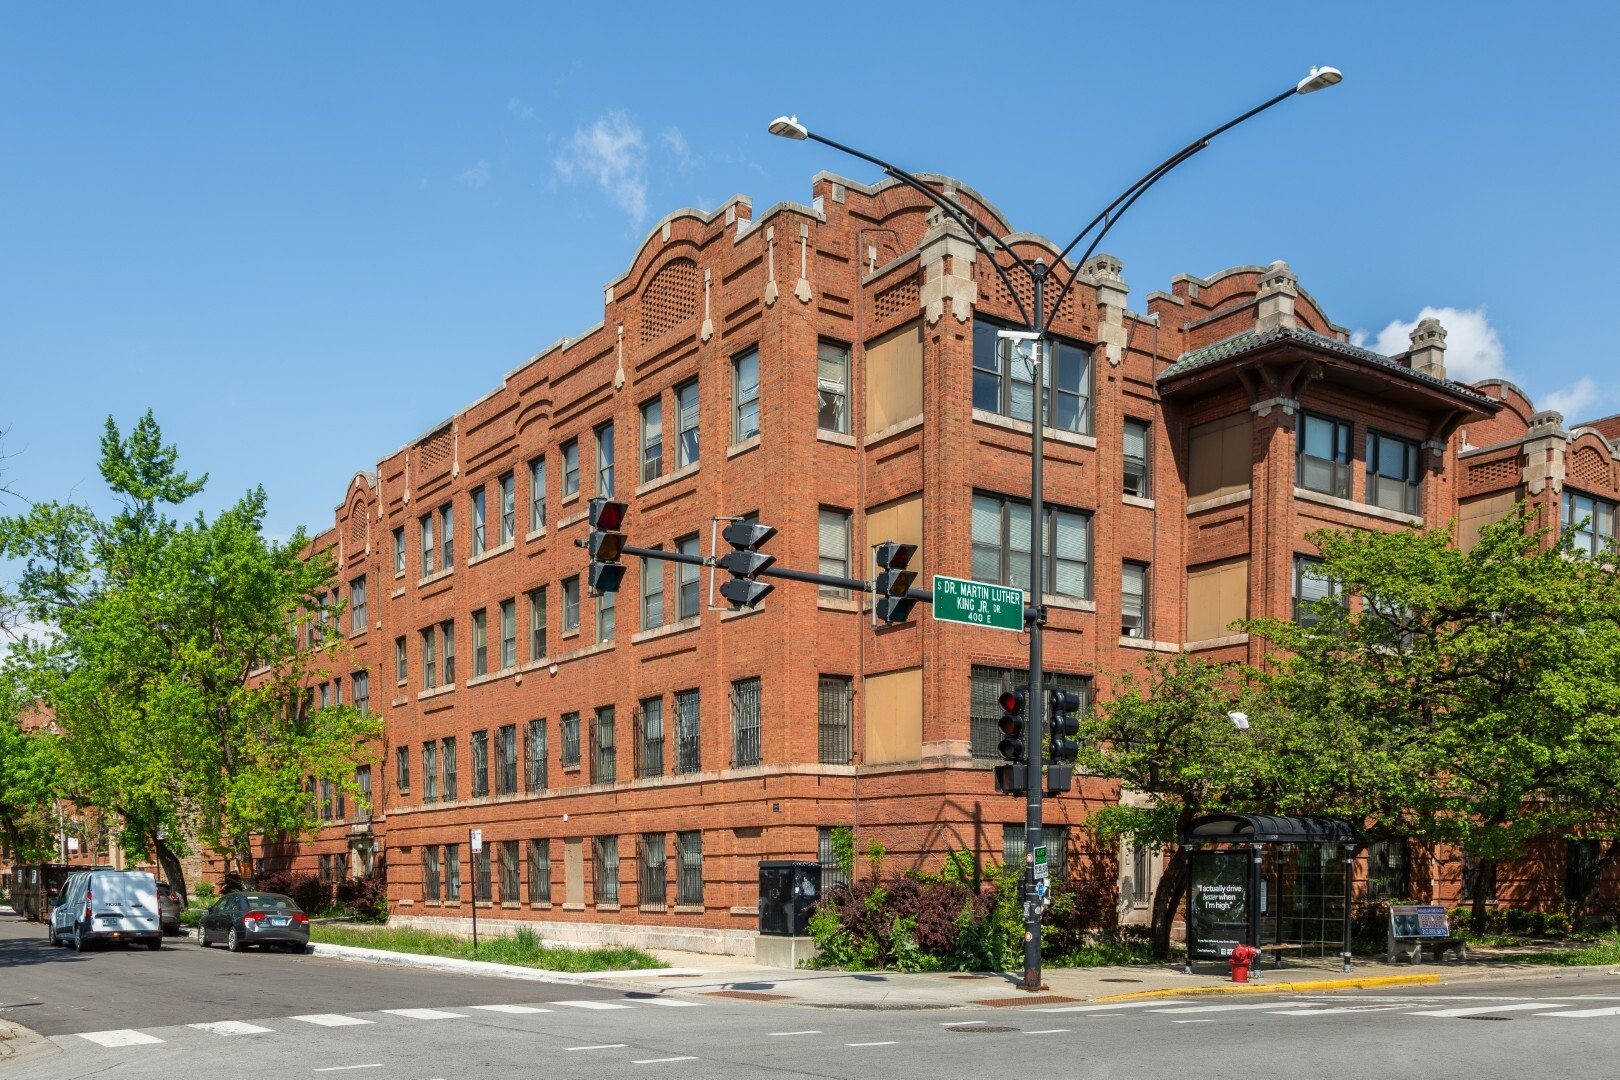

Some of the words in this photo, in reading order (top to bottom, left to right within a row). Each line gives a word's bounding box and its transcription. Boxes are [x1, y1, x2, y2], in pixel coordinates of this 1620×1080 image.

[937, 581, 942, 590] S
[944, 581, 957, 595] DR.
[960, 583, 989, 600] MARTIN
[992, 589, 1020, 605] LUTHER
[957, 597, 974, 611] KING
[977, 601, 990, 613] JR.
[993, 604, 1002, 613] DR.
[968, 612, 983, 622] 400
[987, 615, 991, 623] E
[1203, 885, 1226, 893] actually
[1203, 893, 1219, 901] better
[1219, 893, 1236, 901] when
[1205, 901, 1216, 909] I'm
